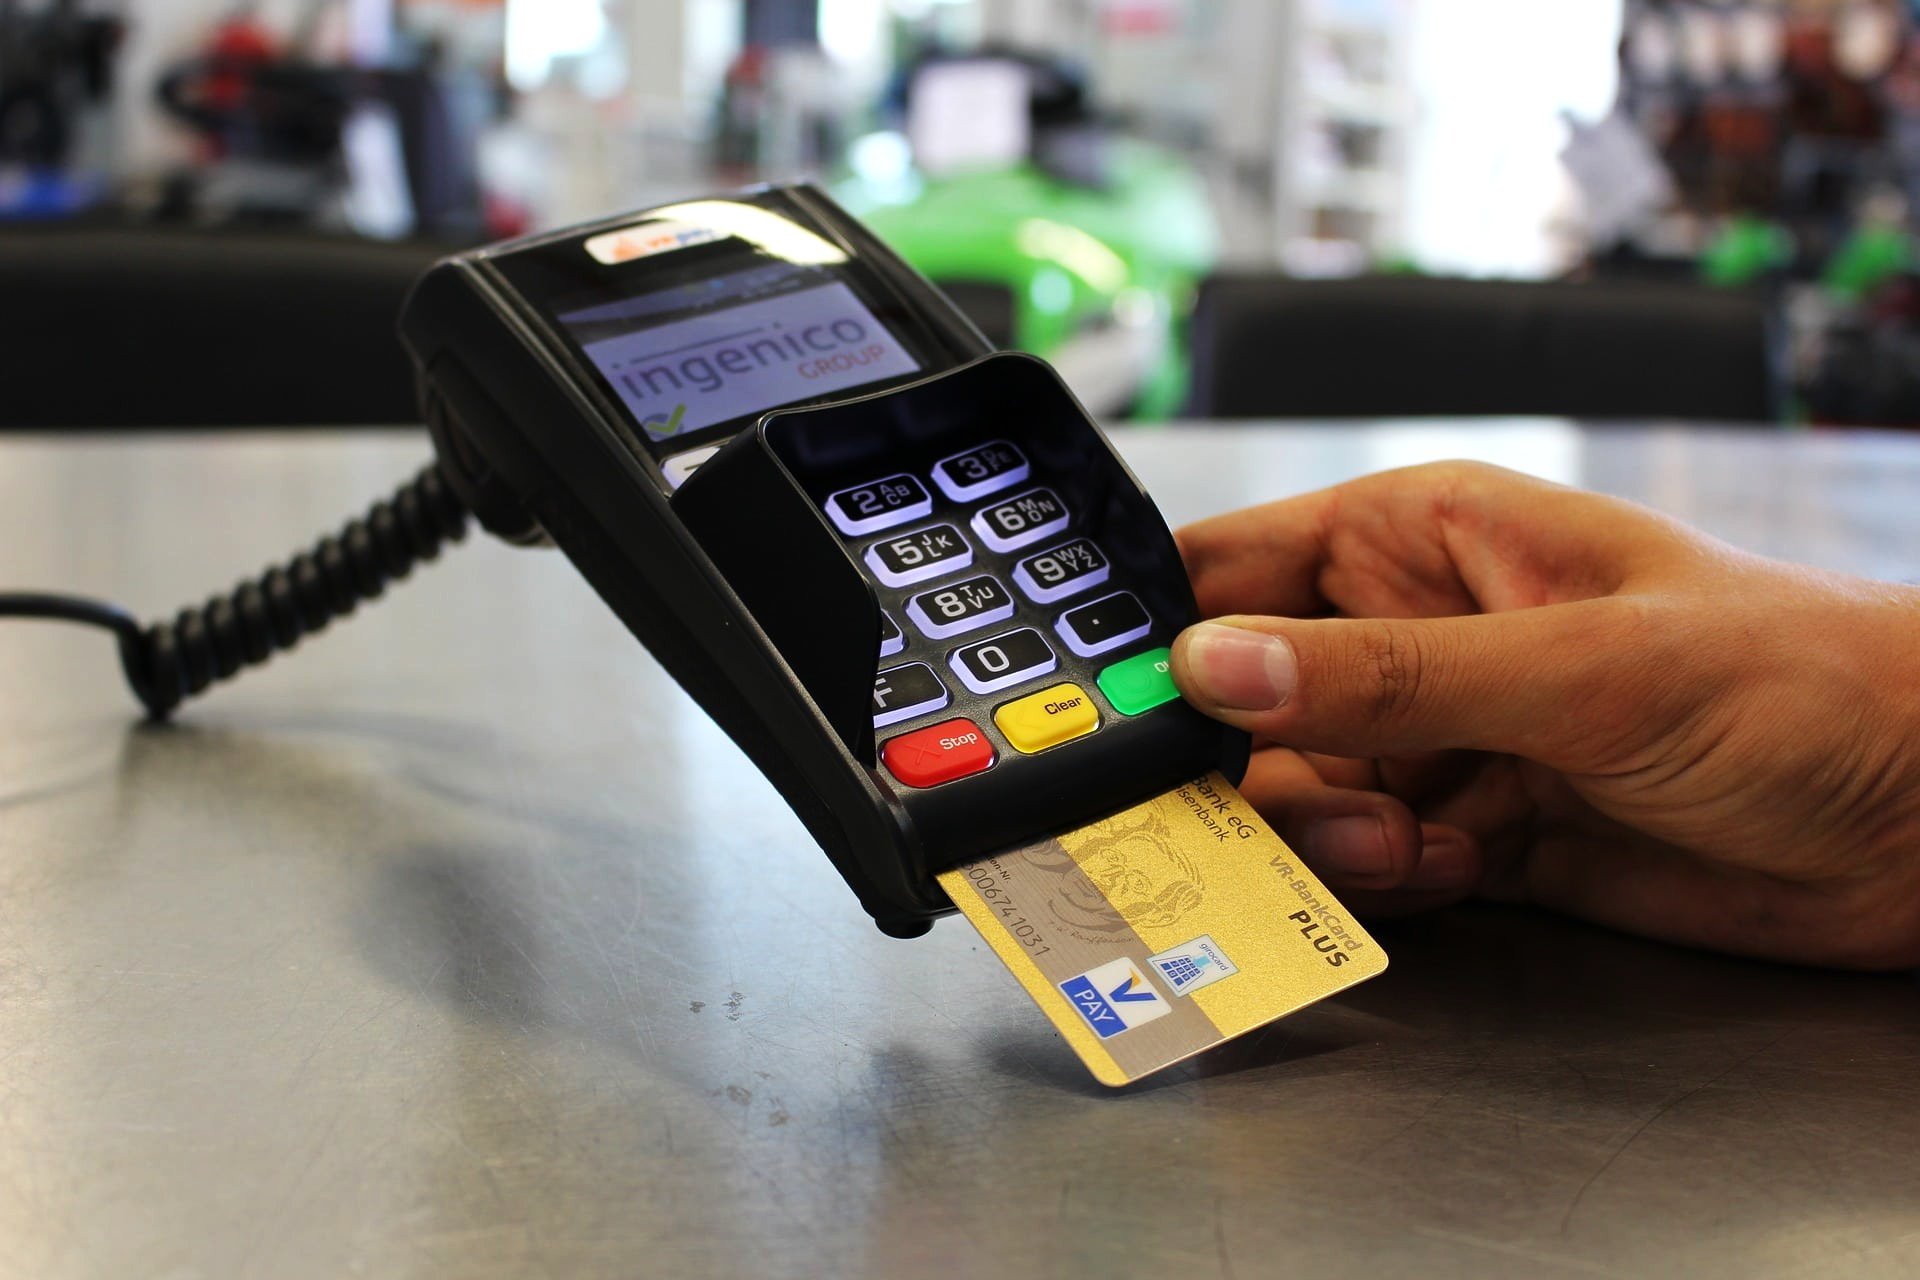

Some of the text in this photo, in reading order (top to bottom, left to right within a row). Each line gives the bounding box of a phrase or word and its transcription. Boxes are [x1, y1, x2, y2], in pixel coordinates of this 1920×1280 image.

[611, 318, 867, 399] ingenico
[797, 344, 886, 380] GROUP
[957, 456, 989, 479] 3
[851, 489, 885, 514] 2
[994, 506, 1026, 531] 6
[890, 538, 925, 566] 5
[1034, 557, 1066, 582] 9
[934, 591, 967, 618] 8
[976, 645, 1010, 673] 0
[1044, 696, 1082, 715] Clear
[939, 731, 978, 751] Stop
[1227, 815, 1258, 840] eG
[1268, 854, 1364, 951] VR-BankCard
[1287, 909, 1350, 967] PLUS
[1199, 942, 1230, 971] girocard
[1073, 988, 1116, 1022] PAY
